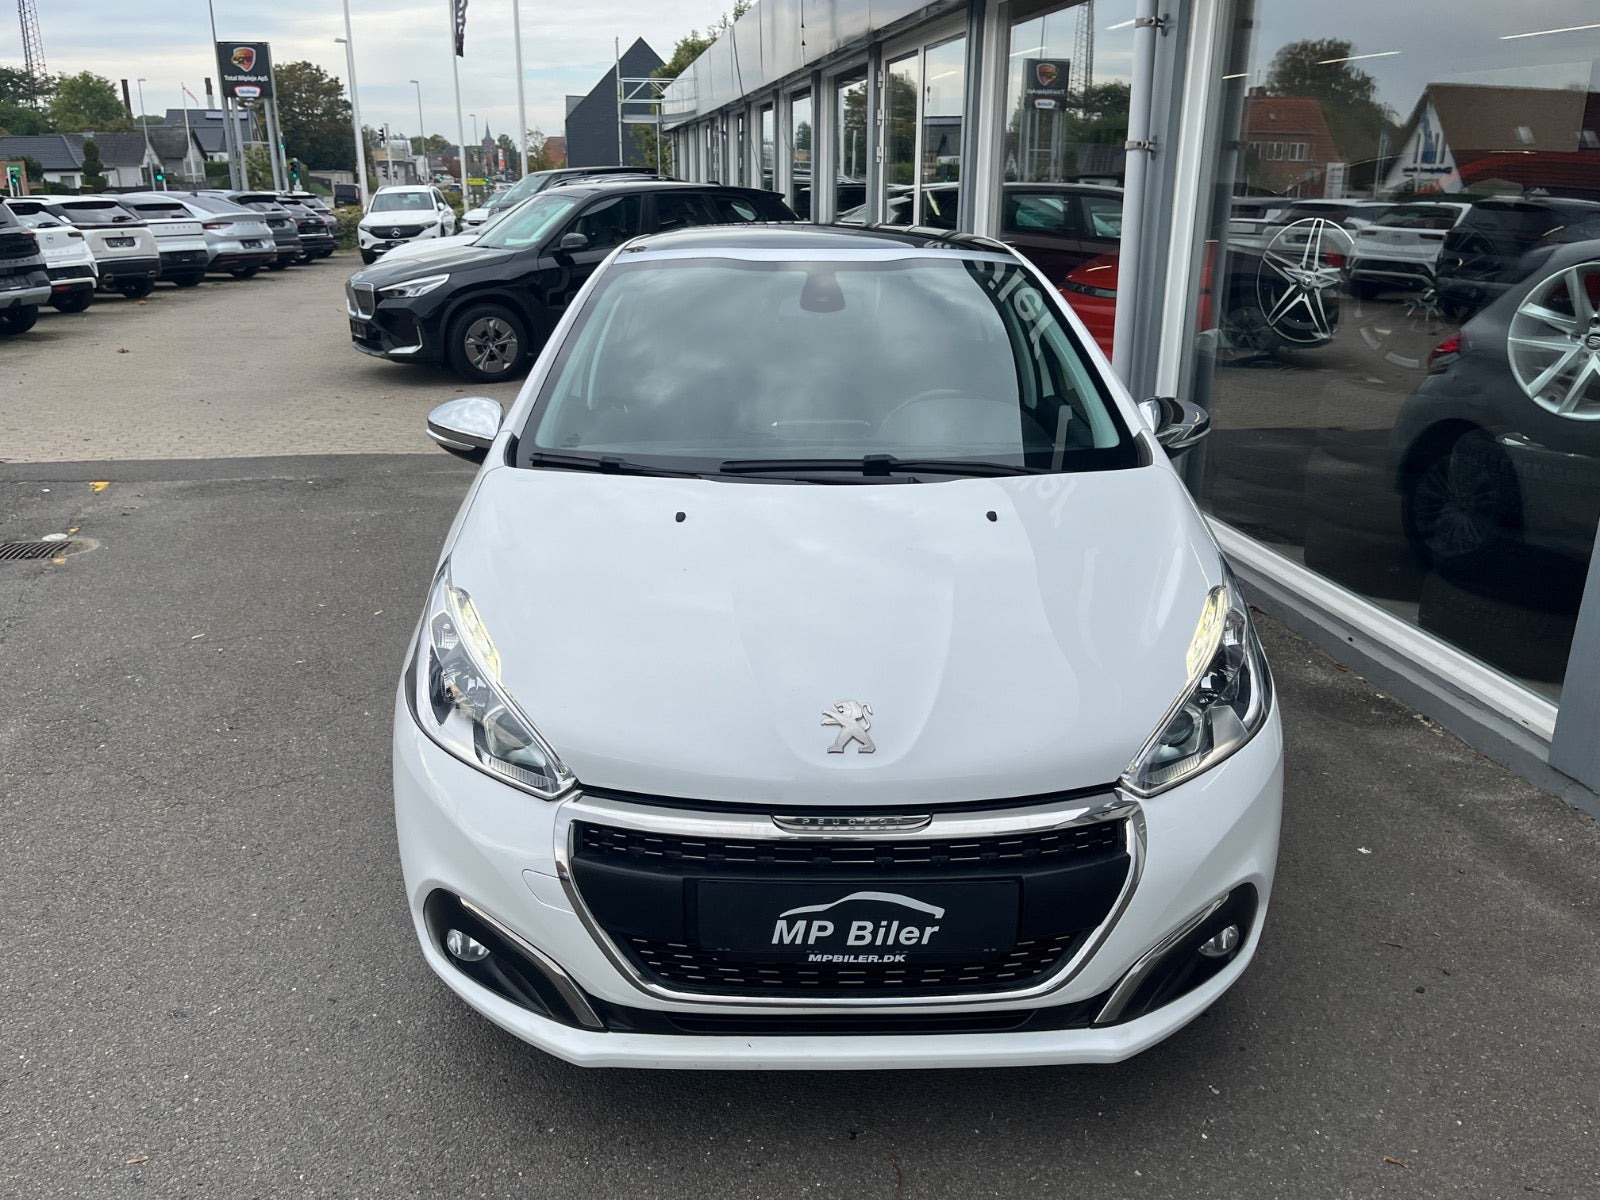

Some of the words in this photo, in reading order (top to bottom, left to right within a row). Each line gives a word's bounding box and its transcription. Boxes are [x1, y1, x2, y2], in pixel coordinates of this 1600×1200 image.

[771, 919, 834, 945] MP
[846, 920, 940, 946] Biler
[808, 953, 907, 963] MPBILER.DK
